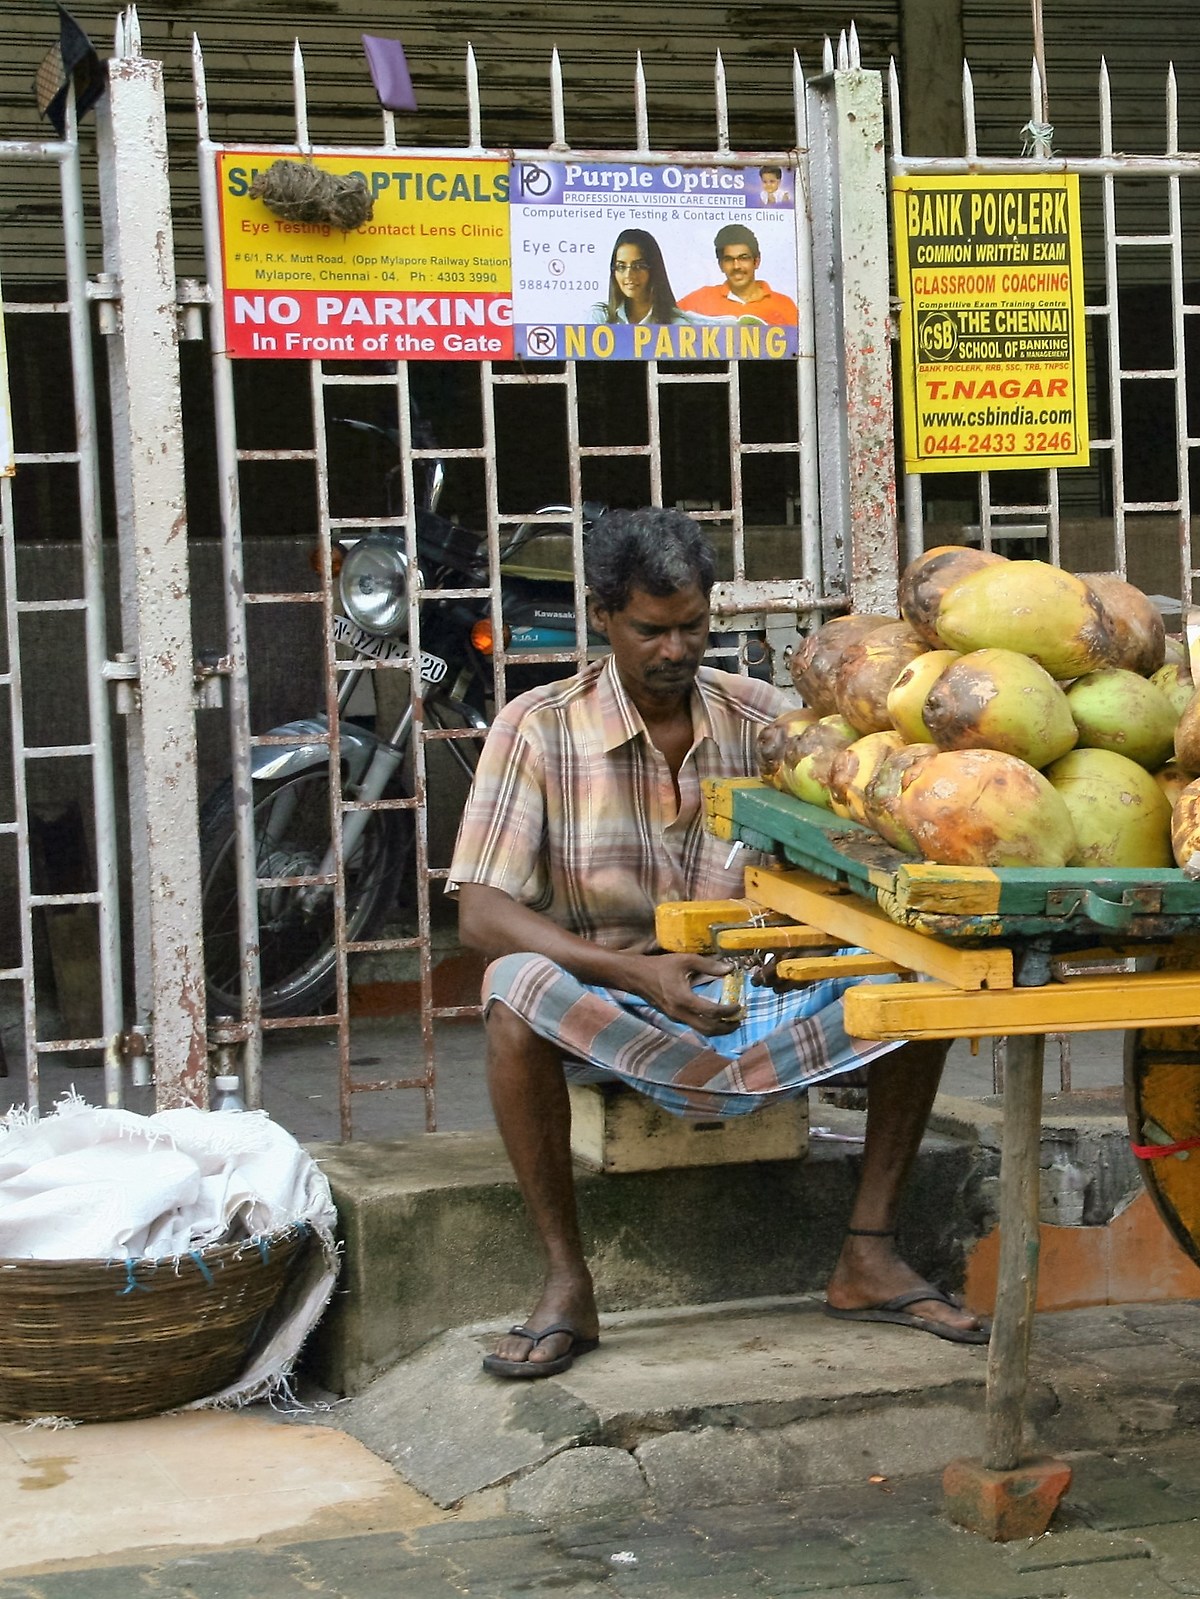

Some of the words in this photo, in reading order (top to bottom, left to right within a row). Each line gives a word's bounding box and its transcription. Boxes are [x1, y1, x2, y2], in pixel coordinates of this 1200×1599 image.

[349, 171, 510, 202] PTICALS
[564, 165, 654, 192] Purple
[662, 167, 745, 193] Optics
[564, 193, 640, 204] PROFESSIONAL
[642, 194, 677, 205] VISION
[679, 195, 705, 205] CARE
[707, 196, 744, 206] CENTRE
[522, 207, 603, 219] Computerised
[606, 209, 626, 220] Eye
[629, 208, 668, 222] Testing
[671, 210, 680, 220] &
[683, 210, 726, 221] Contact
[728, 211, 752, 221] Lens
[755, 211, 785, 222] Clinic
[908, 193, 963, 236] BANK
[241, 220, 270, 235] Eye
[274, 220, 331, 236] Testing
[420, 224, 456, 236] Lens
[461, 224, 504, 237] Clinic
[522, 240, 551, 255] Eye
[558, 240, 596, 254] Care
[917, 244, 971, 263] COMMON
[975, 243, 1029, 261] WRITTEN
[1033, 243, 1066, 260] EXAM
[290, 254, 314, 263] Mutt
[352, 255, 378, 266] (Opp
[380, 256, 428, 267] Mylapore
[430, 256, 469, 267] Railway
[319, 270, 371, 281] Chennai
[410, 271, 426, 282] Ph
[437, 272, 465, 283] 4303
[469, 272, 497, 283] 3990
[519, 279, 599, 291] 9884701200
[914, 275, 996, 294] CLASSROOM
[1001, 272, 1069, 293] COACHING
[233, 296, 301, 325] NO
[316, 297, 513, 327] PARKING
[918, 301, 972, 310] Competitive
[999, 300, 1035, 309] Training
[957, 311, 991, 333] THE
[995, 310, 1067, 332] CHENNAI
[252, 332, 276, 351] In
[285, 333, 354, 352] Front
[362, 333, 389, 352] of
[395, 334, 436, 352] the
[443, 334, 502, 352] Gate
[565, 325, 615, 358] NO
[634, 325, 787, 359] PARKING
[923, 320, 953, 351] CSB
[1019, 339, 1068, 350] BANKING
[958, 341, 1002, 359] SCHOOL
[1005, 340, 1019, 358] OF
[1026, 350, 1069, 358] MANAGEMENT
[919, 365, 941, 373] BANK
[1044, 362, 1069, 371] TNPSC
[926, 379, 1068, 400] T.NAGAR
[922, 406, 1072, 427] www.csbindia.com
[924, 433, 1016, 454] 044-2433
[1023, 432, 1072, 451] 3246
[534, 610, 576, 619] Kawasaki
